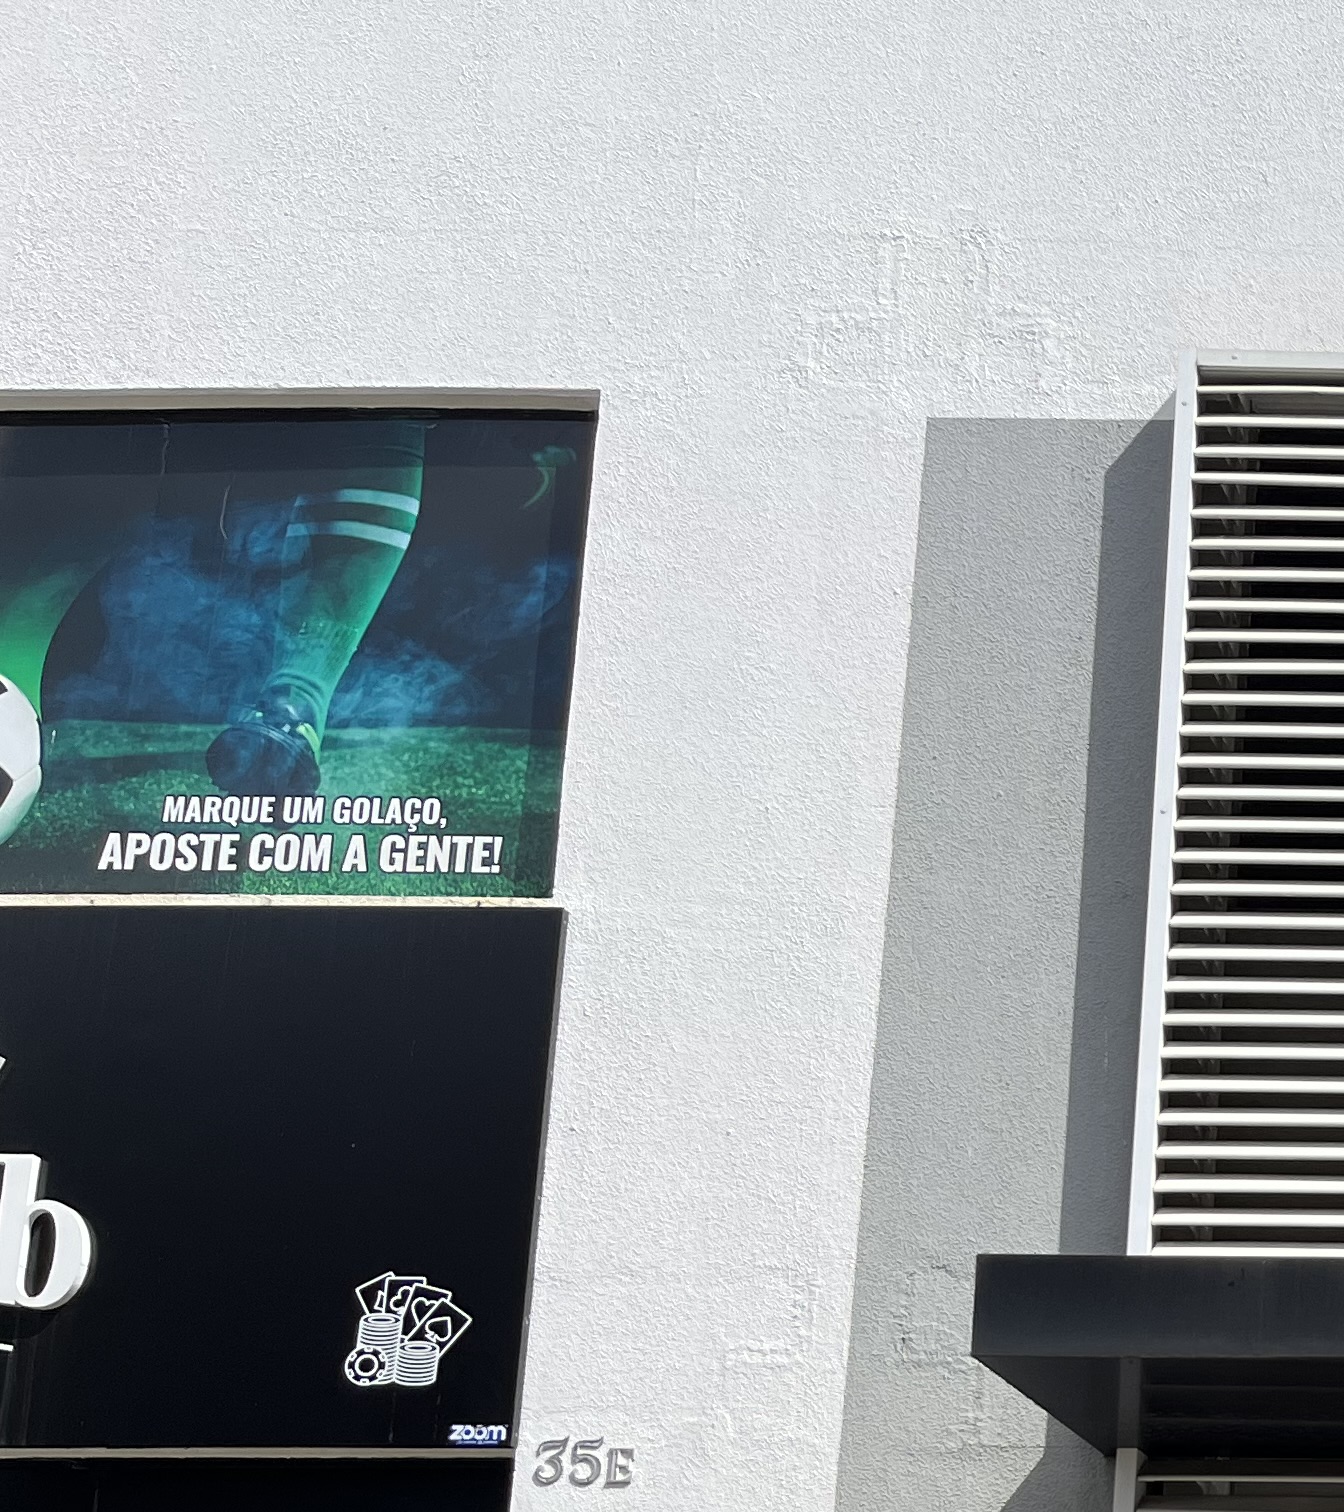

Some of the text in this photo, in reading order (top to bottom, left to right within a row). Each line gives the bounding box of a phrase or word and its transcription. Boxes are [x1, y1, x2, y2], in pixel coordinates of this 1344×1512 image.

[161, 795, 448, 833] MARQUE UM GOLAÇO,
[97, 832, 504, 874] APOSTE COM A GENTE!
[532, 1436, 635, 1489] 35E
